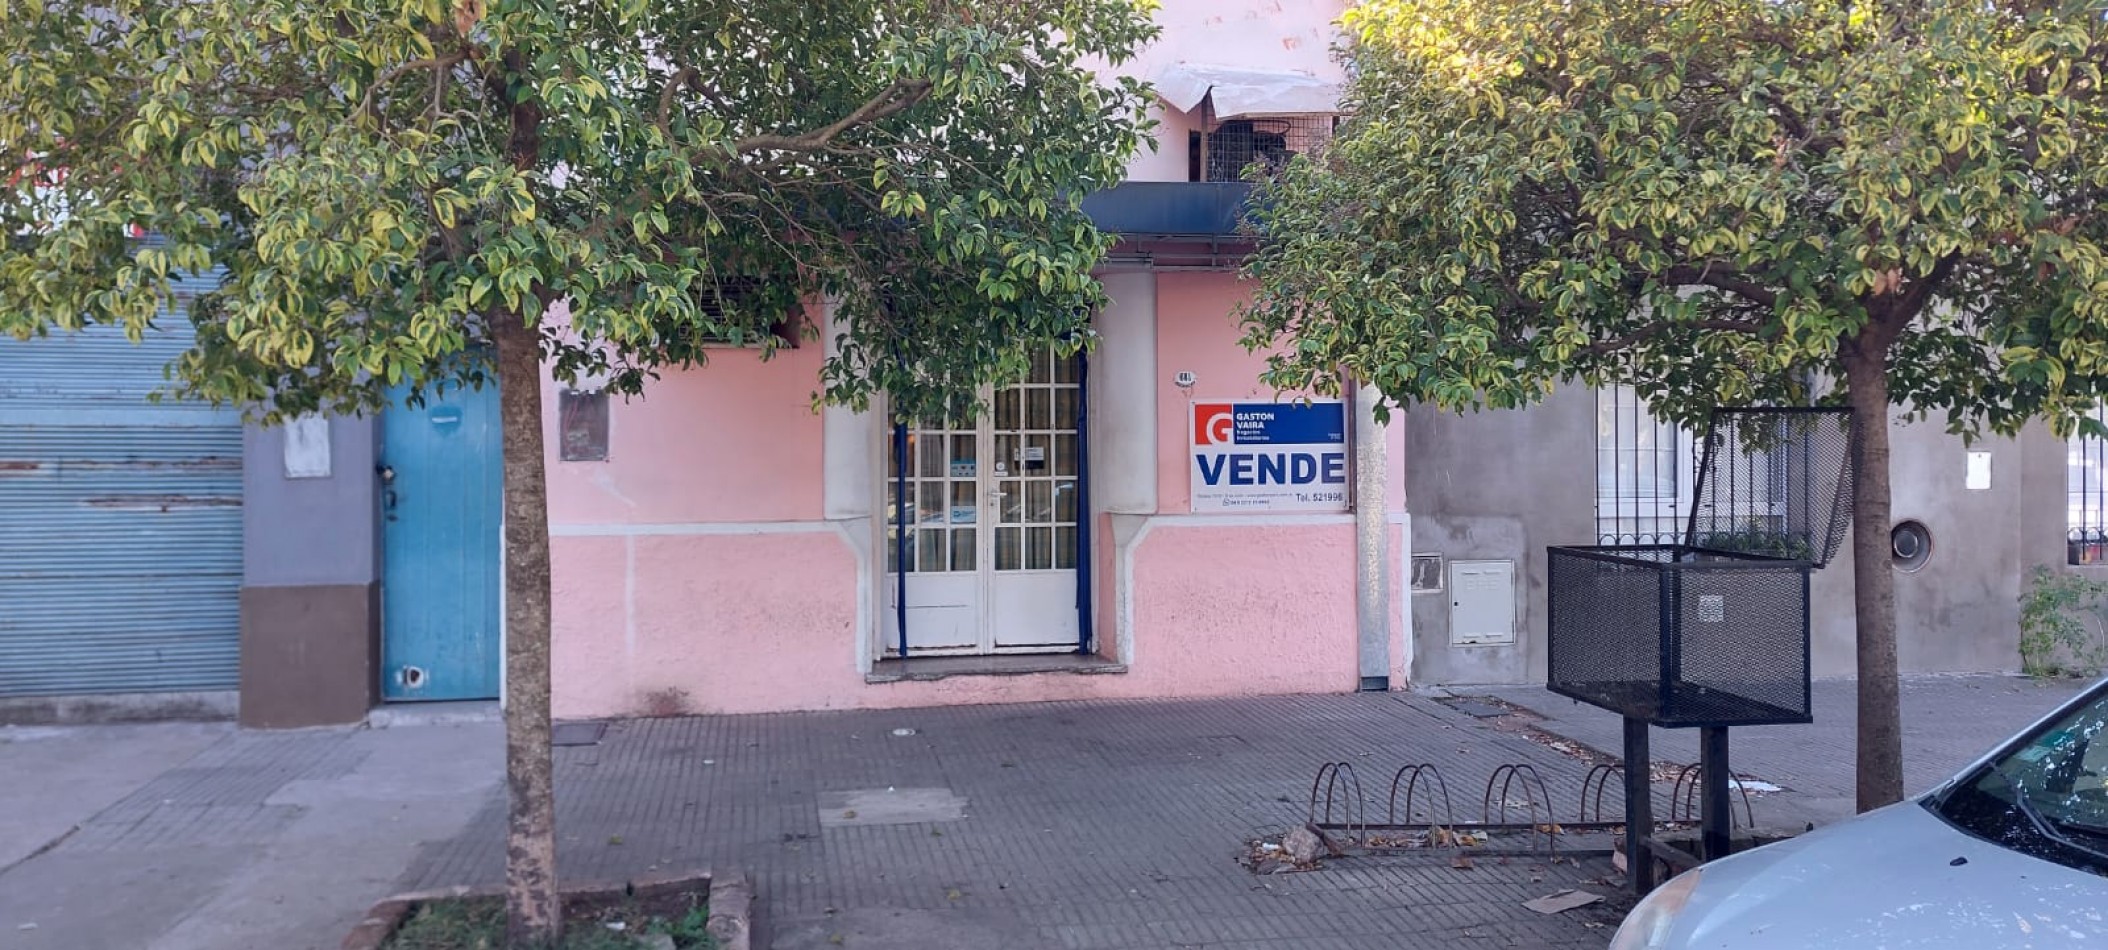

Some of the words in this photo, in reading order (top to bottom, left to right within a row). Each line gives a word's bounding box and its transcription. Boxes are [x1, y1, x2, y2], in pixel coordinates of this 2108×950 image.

[1236, 413, 1275, 421] GASTON
[1206, 412, 1233, 444] G
[1236, 421, 1265, 429] VAIRA
[1196, 453, 1345, 485] VENDE
[1296, 493, 1310, 502] Tel.
